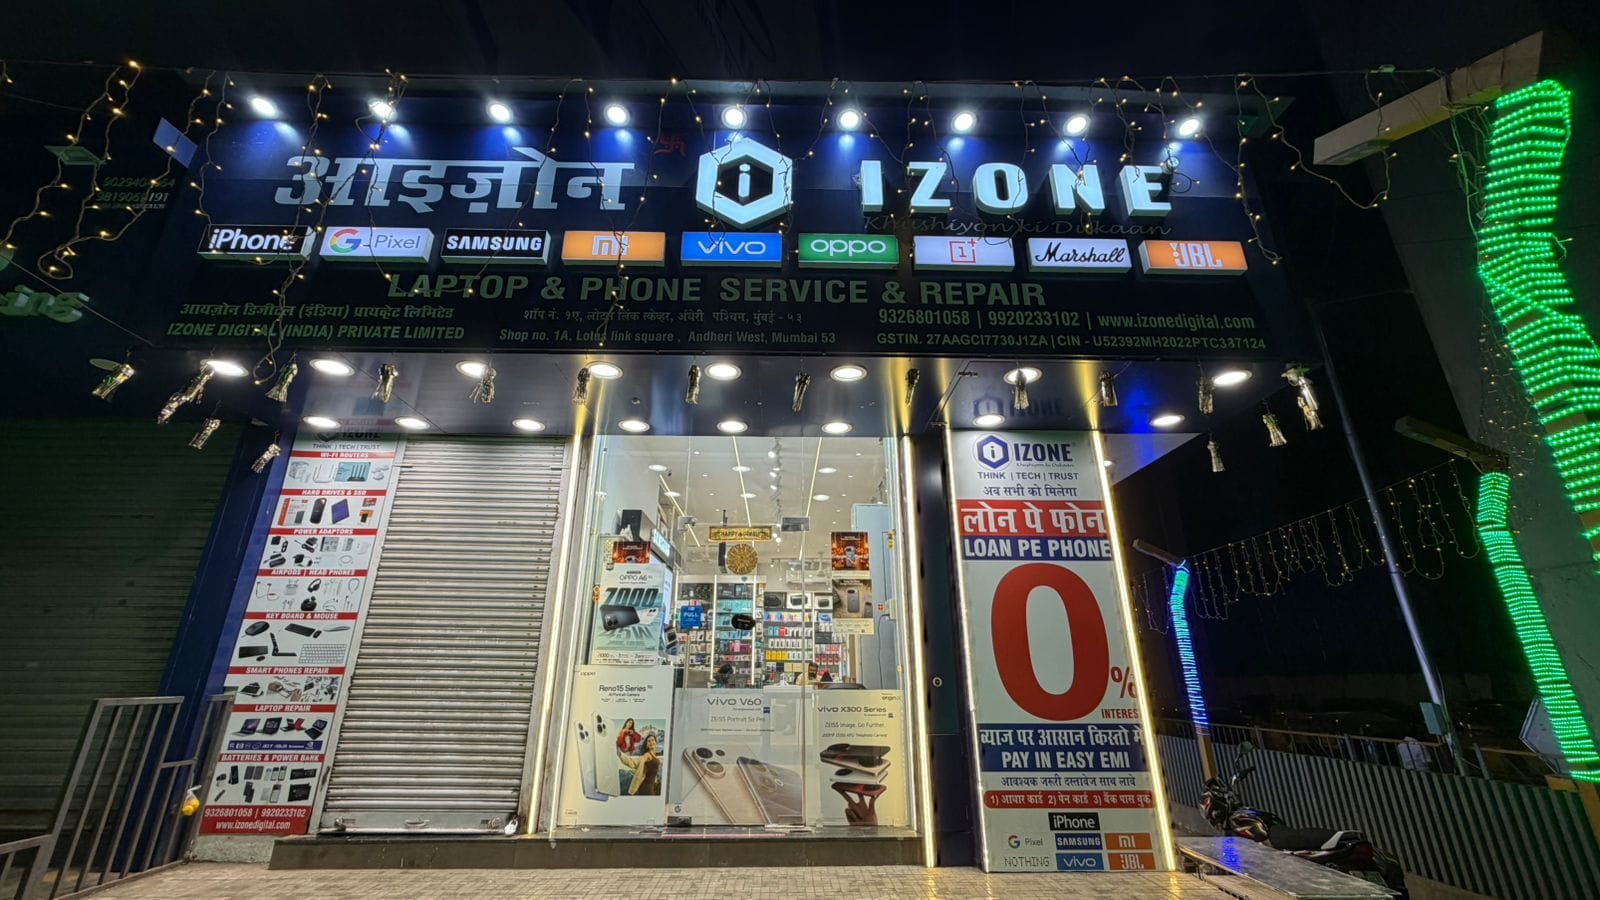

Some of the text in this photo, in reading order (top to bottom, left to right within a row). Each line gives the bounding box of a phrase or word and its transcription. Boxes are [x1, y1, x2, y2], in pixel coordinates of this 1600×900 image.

[274, 146, 634, 213] आइज़ोन
[860, 159, 1172, 217] IZONE
[865, 215, 1172, 240] Khushiyon ki Dukaan
[211, 228, 294, 251] iPhone
[374, 234, 422, 250] Pixel
[447, 236, 542, 251] SAMSUNG
[697, 238, 766, 256] vivo
[810, 238, 886, 256] oppo
[1035, 241, 1125, 263] Marshall
[1169, 243, 1224, 268] JBL
[387, 274, 1047, 306] LAPTOP & PHONE SERVICE & REPAIR
[299, 303, 349, 319] (इंडिया)
[879, 309, 1255, 332] 9326801058 9920233102 www.izonedigital.com
[167, 323, 216, 336] IZONE
[217, 323, 277, 337] DIGITAL
[337, 325, 401, 339] PRIVATE
[404, 326, 465, 340] LIMITED
[499, 328, 528, 343] Shop
[532, 331, 549, 341] no.
[576, 330, 606, 342] Lotus
[611, 330, 631, 342] link
[635, 332, 674, 344] square
[688, 331, 732, 343] Andheri
[736, 332, 768, 344] West,
[772, 332, 817, 343] Mumbai
[821, 333, 835, 344] 53
[876, 333, 922, 344] GSTIN.
[1057, 335, 1080, 346] CIN
[1014, 443, 1073, 461] IZONE
[1016, 472, 1041, 480] TECH
[984, 484, 1077, 496] अब सभी को मिलेगा
[961, 501, 1107, 533] लोन पे फोन
[964, 538, 1112, 558] LOAN PE PHONE
[606, 587, 659, 607] 7000
[991, 563, 1109, 721] 0
[707, 697, 737, 705] vivo
[1101, 708, 1139, 719] INTERES
[979, 729, 1014, 745] ब्याज
[1016, 729, 1035, 745] पर
[1037, 729, 1085, 746] आसान
[1001, 751, 1130, 769] PAY IN EASY EMI
[990, 795, 999, 806] 1)
[1048, 795, 1057, 806] 2)
[1093, 795, 1102, 806] 3)
[205, 808, 306, 818] 9326801058 9920233102
[216, 820, 291, 830] www.izonedigital.com
[1053, 815, 1095, 829] iPhone
[1025, 838, 1043, 846] Pixel
[1057, 837, 1100, 846] SAMSUNG
[1004, 856, 1050, 867] NOTHING
[1064, 855, 1096, 867] vivo
[1121, 855, 1144, 869] JBL
